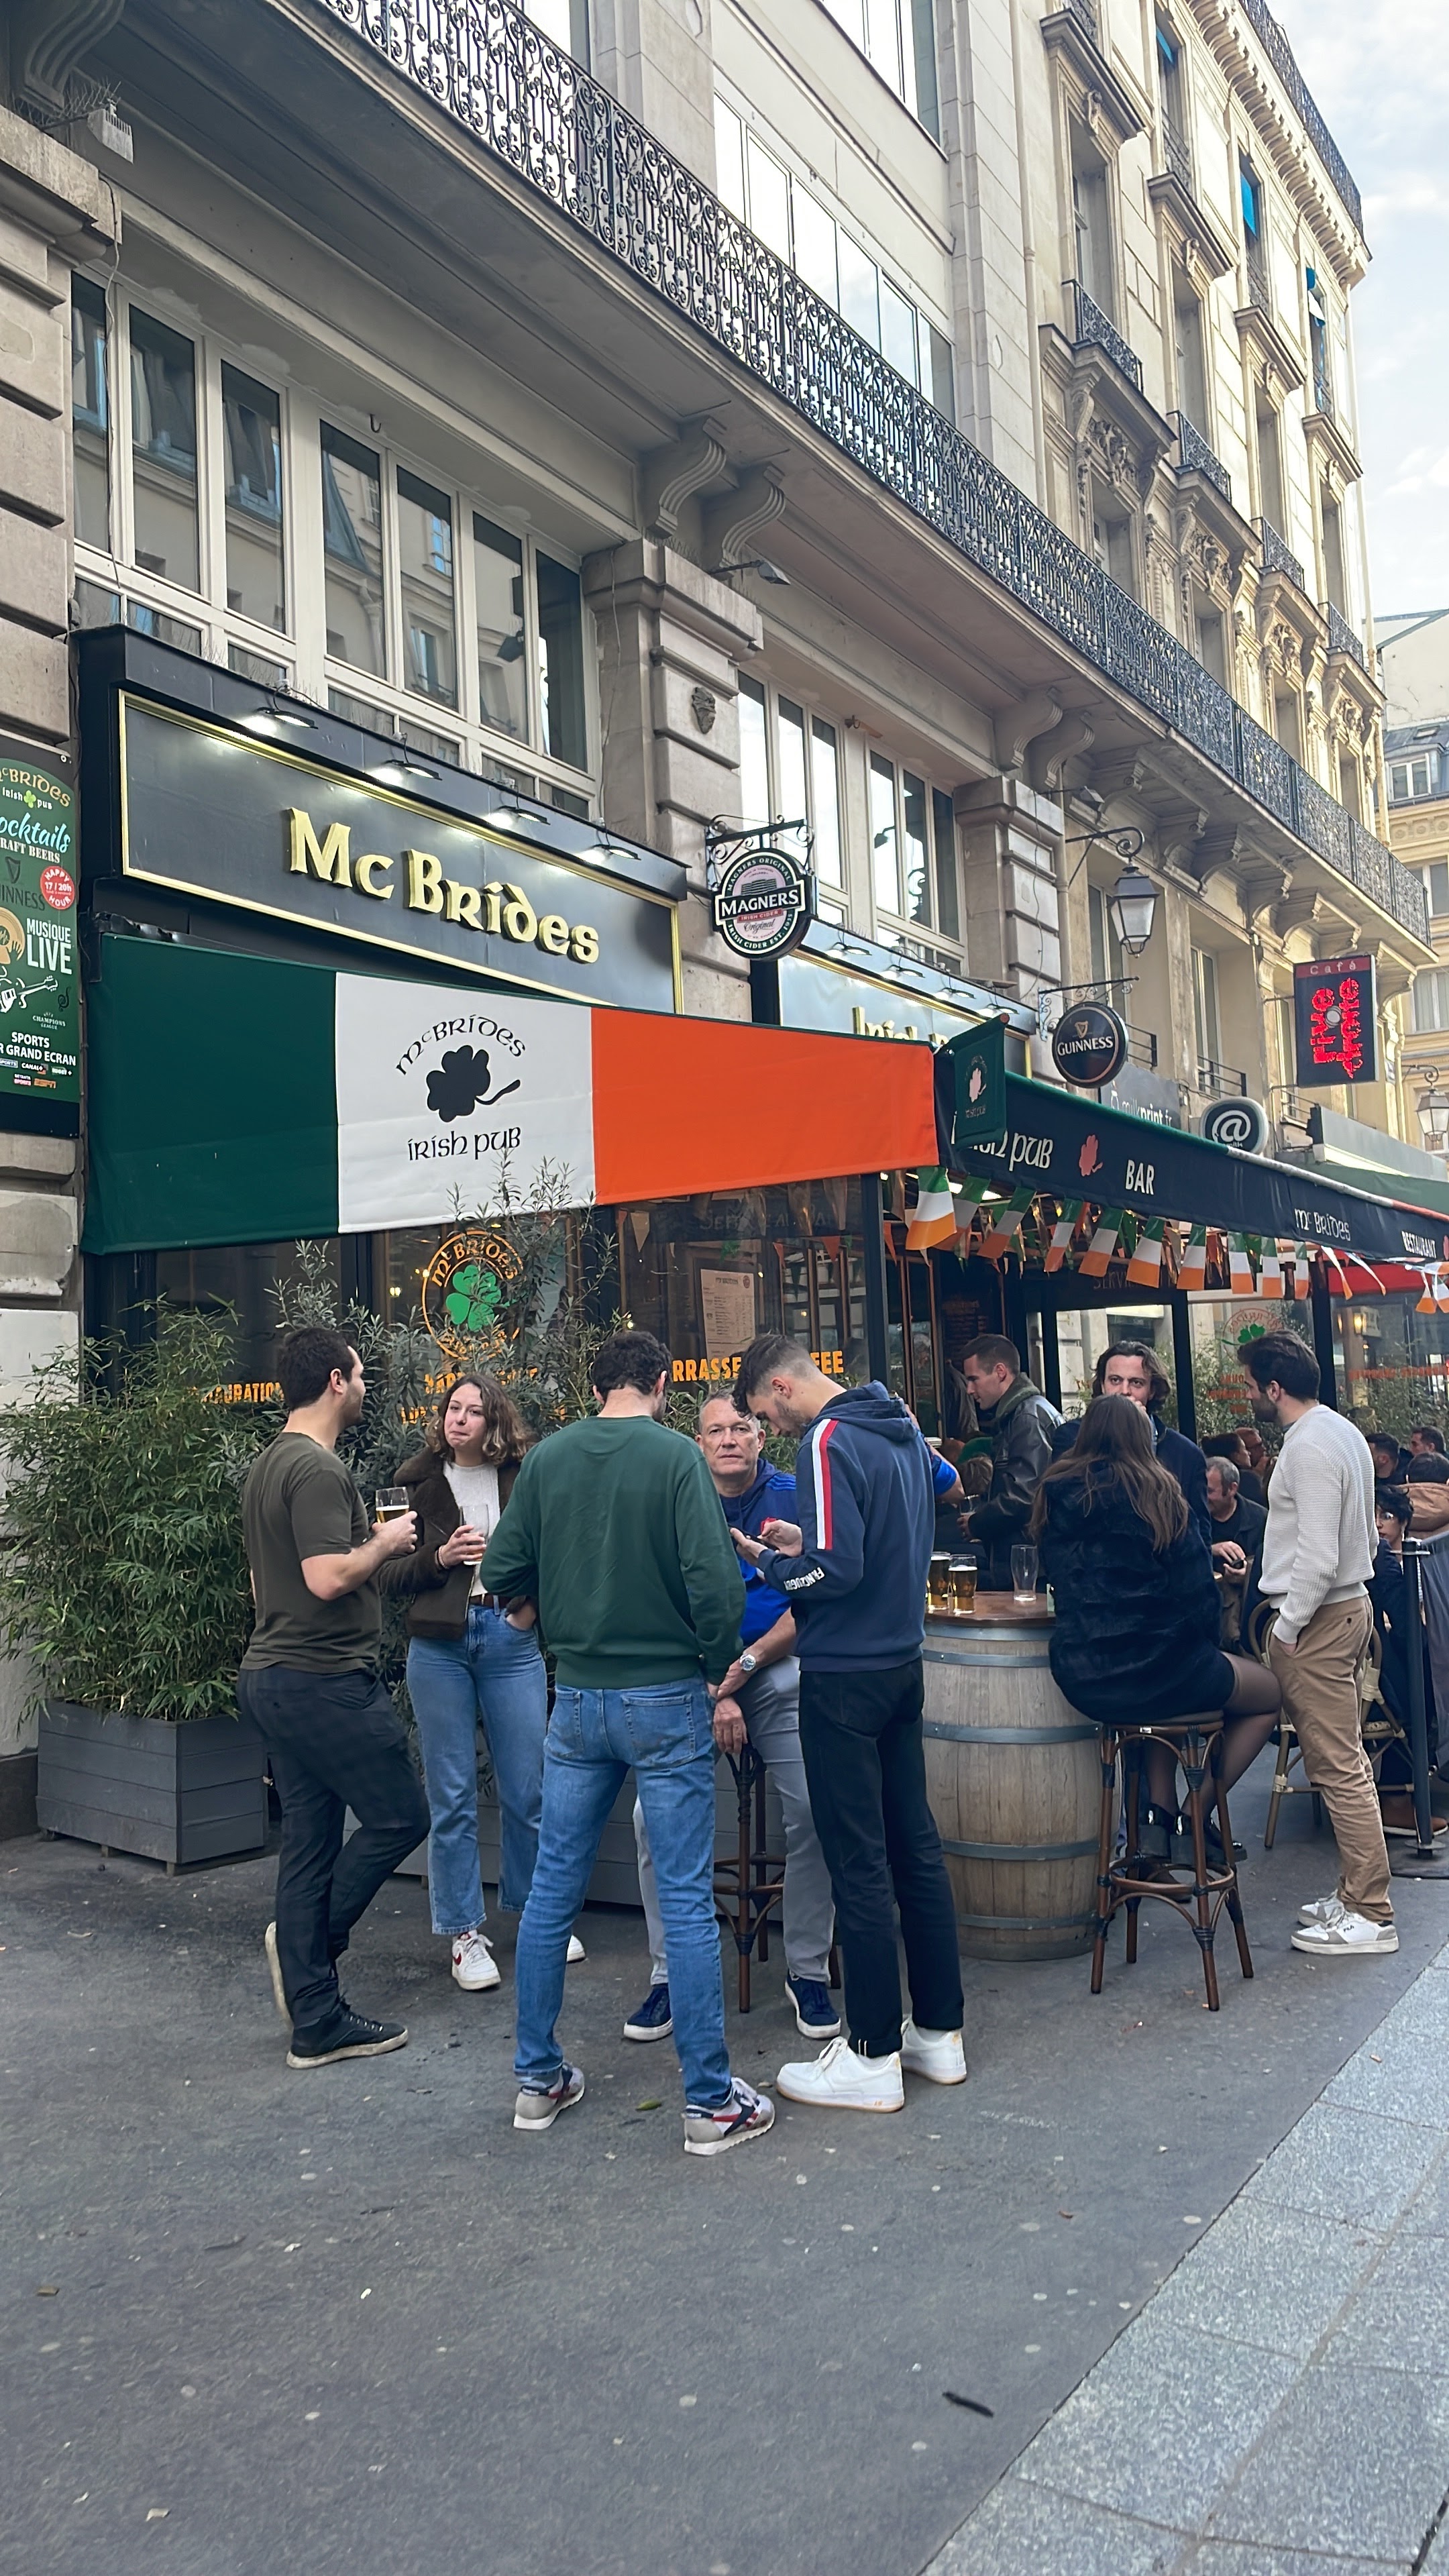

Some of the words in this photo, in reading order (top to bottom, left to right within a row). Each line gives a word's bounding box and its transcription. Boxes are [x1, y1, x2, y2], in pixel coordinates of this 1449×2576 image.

[0, 812, 71, 853] ocktails
[0, 837, 26, 855] RAFT
[29, 846, 60, 863] BEERS
[290, 807, 395, 900] Mc
[44, 869, 70, 882] HAPPY
[727, 859, 756, 892] MAGNERS
[759, 858, 791, 881] ORIGINAL
[0, 883, 46, 911] INNESS
[58, 883, 72, 892] 20h
[49, 895, 71, 906] HOUR
[721, 890, 799, 917] MAGNERS
[743, 918, 776, 934] Original
[759, 910, 779, 918] CIDER
[729, 924, 743, 944] IRISH
[27, 934, 72, 975] LIVE
[32, 1015, 66, 1026] CHAMPIONS
[11, 1031, 50, 1048] SPORTS
[1057, 1036, 1114, 1057] GUINNESS
[6, 1044, 42, 1060] GRAND
[44, 1051, 76, 1066] ECRAN
[1125, 1159, 1155, 1195] BAR
[1401, 1230, 1437, 1259] RESTAURANT
[673, 1356, 742, 1382] RRASSE
